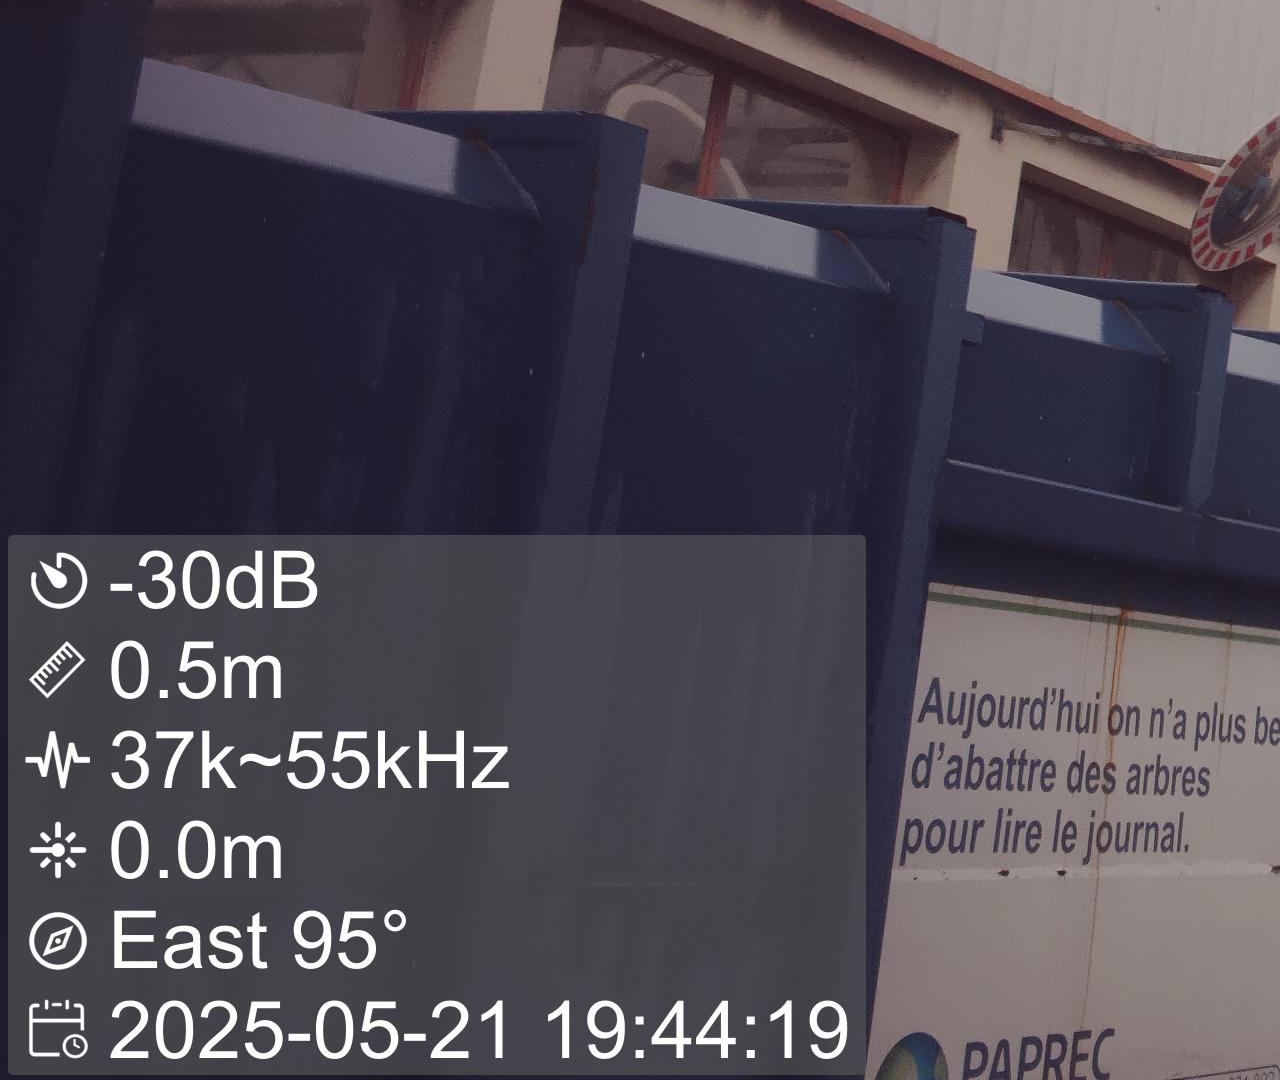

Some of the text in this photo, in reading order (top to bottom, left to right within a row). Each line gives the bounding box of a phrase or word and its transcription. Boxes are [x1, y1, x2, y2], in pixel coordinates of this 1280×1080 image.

[918, 676, 1101, 739] Aujourd'hui
[1107, 703, 1140, 737] on
[1150, 698, 1186, 741] n'a
[1194, 703, 1247, 752] plus
[911, 741, 1211, 797] d'abattre des arbres
[899, 807, 1190, 867] pour lire le journal.
[962, 1027, 1116, 1080] PAPREC
